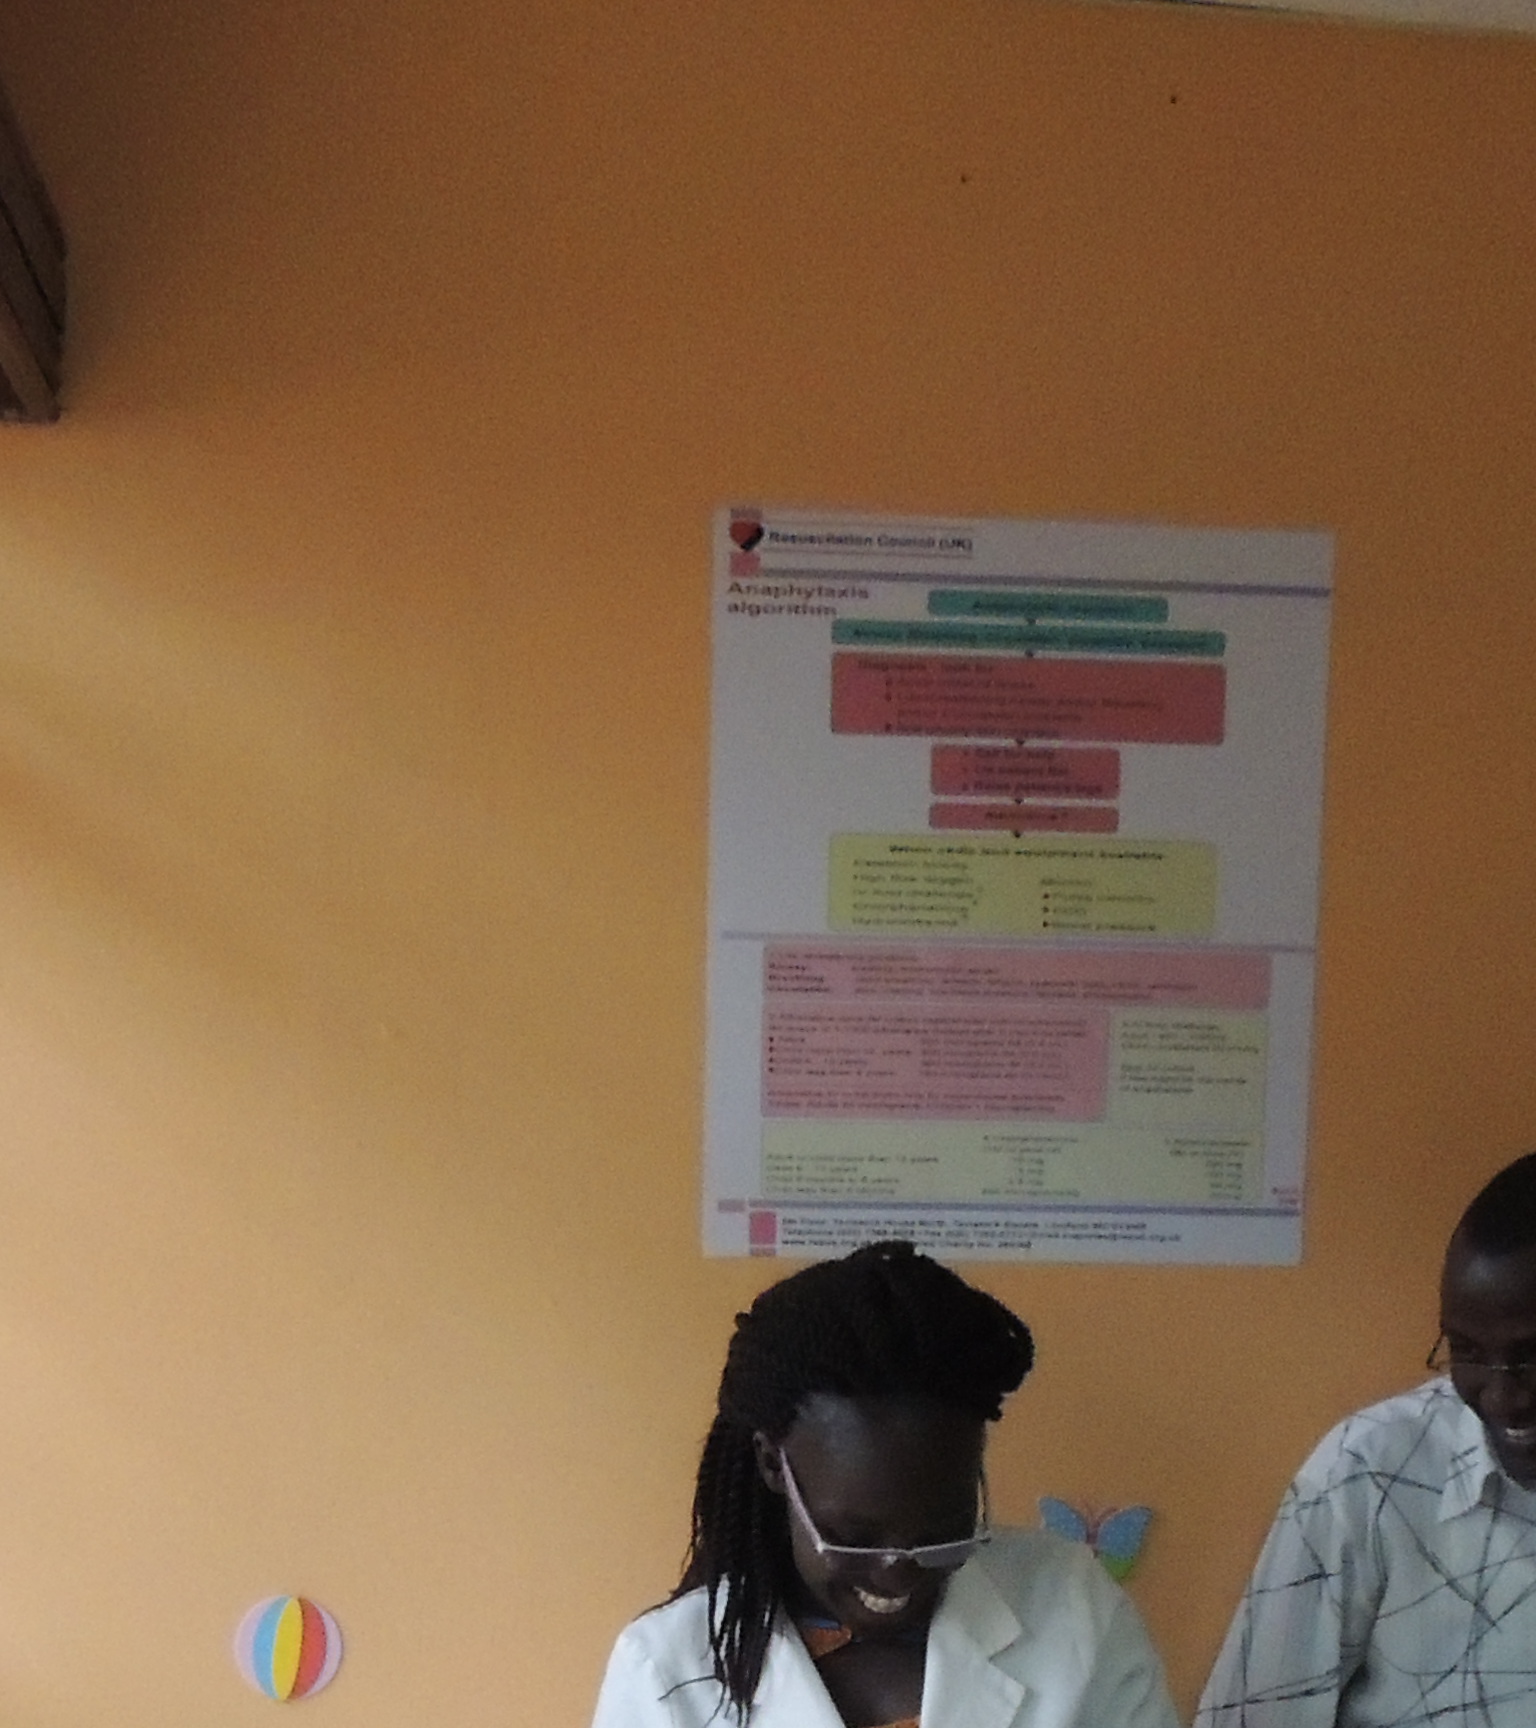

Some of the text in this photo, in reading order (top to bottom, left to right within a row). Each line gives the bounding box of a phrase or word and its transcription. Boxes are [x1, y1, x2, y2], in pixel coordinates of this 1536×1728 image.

[769, 531, 973, 552] Resuscitation Council (UK)
[726, 581, 870, 600] Anaphylaxis
[726, 600, 838, 618] algorithm
